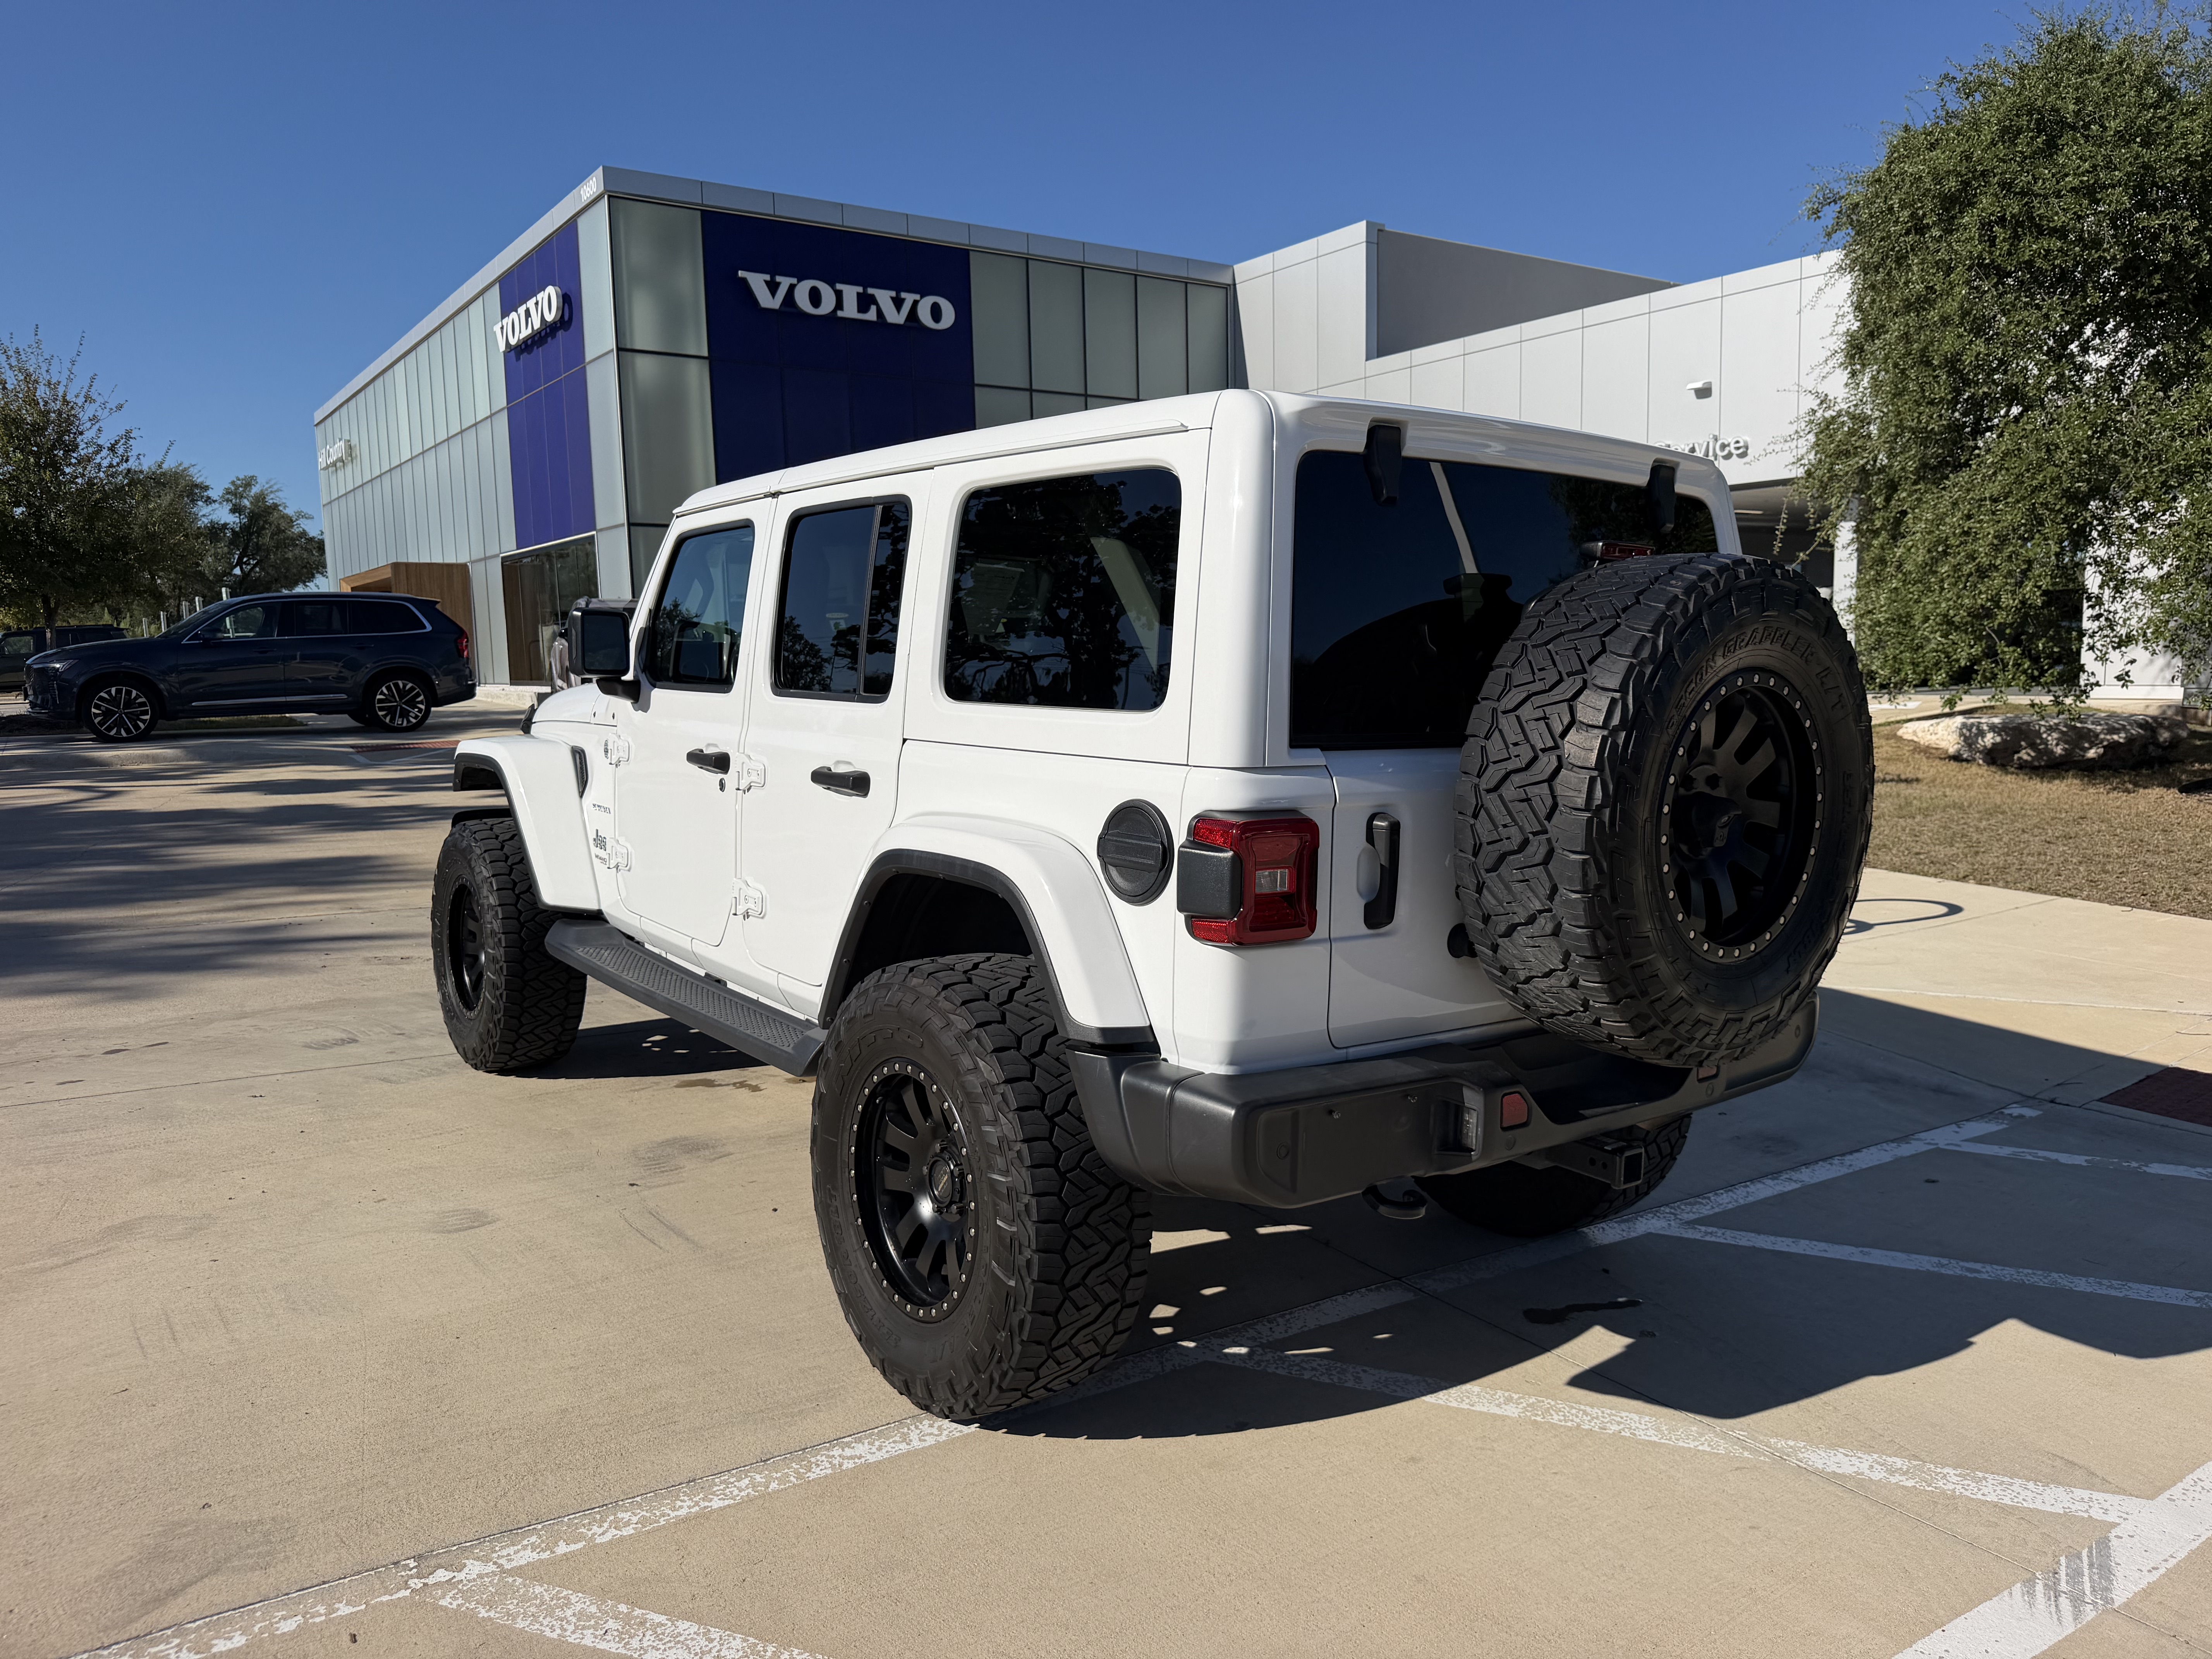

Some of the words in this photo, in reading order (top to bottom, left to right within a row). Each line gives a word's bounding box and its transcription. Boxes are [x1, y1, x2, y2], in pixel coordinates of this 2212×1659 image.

[580, 177, 597, 202] 10600
[493, 285, 557, 352] VOLVO
[738, 270, 956, 330] VOLVO
[1723, 626, 1819, 667] GRAPPLER
[593, 829, 606, 852] Jee
